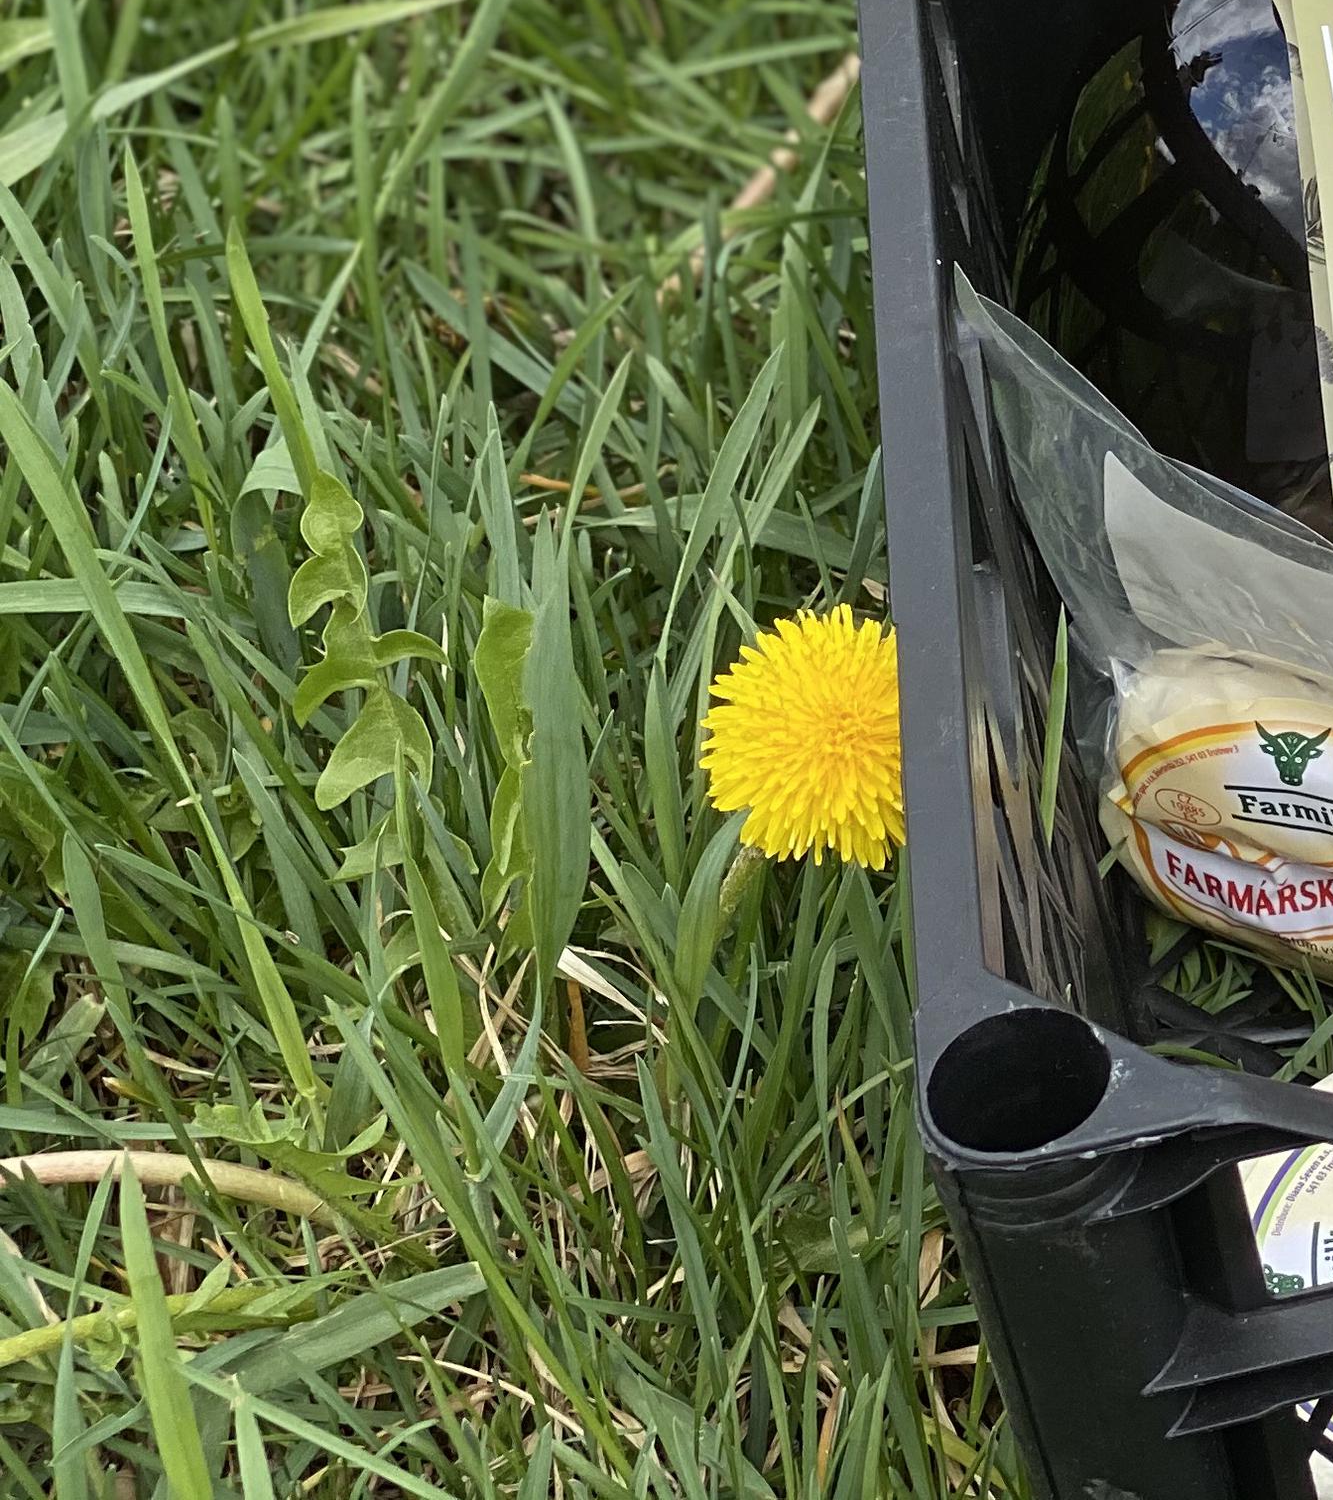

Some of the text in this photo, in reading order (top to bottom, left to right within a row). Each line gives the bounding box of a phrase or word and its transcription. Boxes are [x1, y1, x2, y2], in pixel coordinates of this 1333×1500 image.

[1285, 1180, 1305, 1203] Diana
[1299, 1161, 1321, 1185] Seven
[1305, 1178, 1321, 1195] 541
[1315, 1170, 1328, 1182] 03
